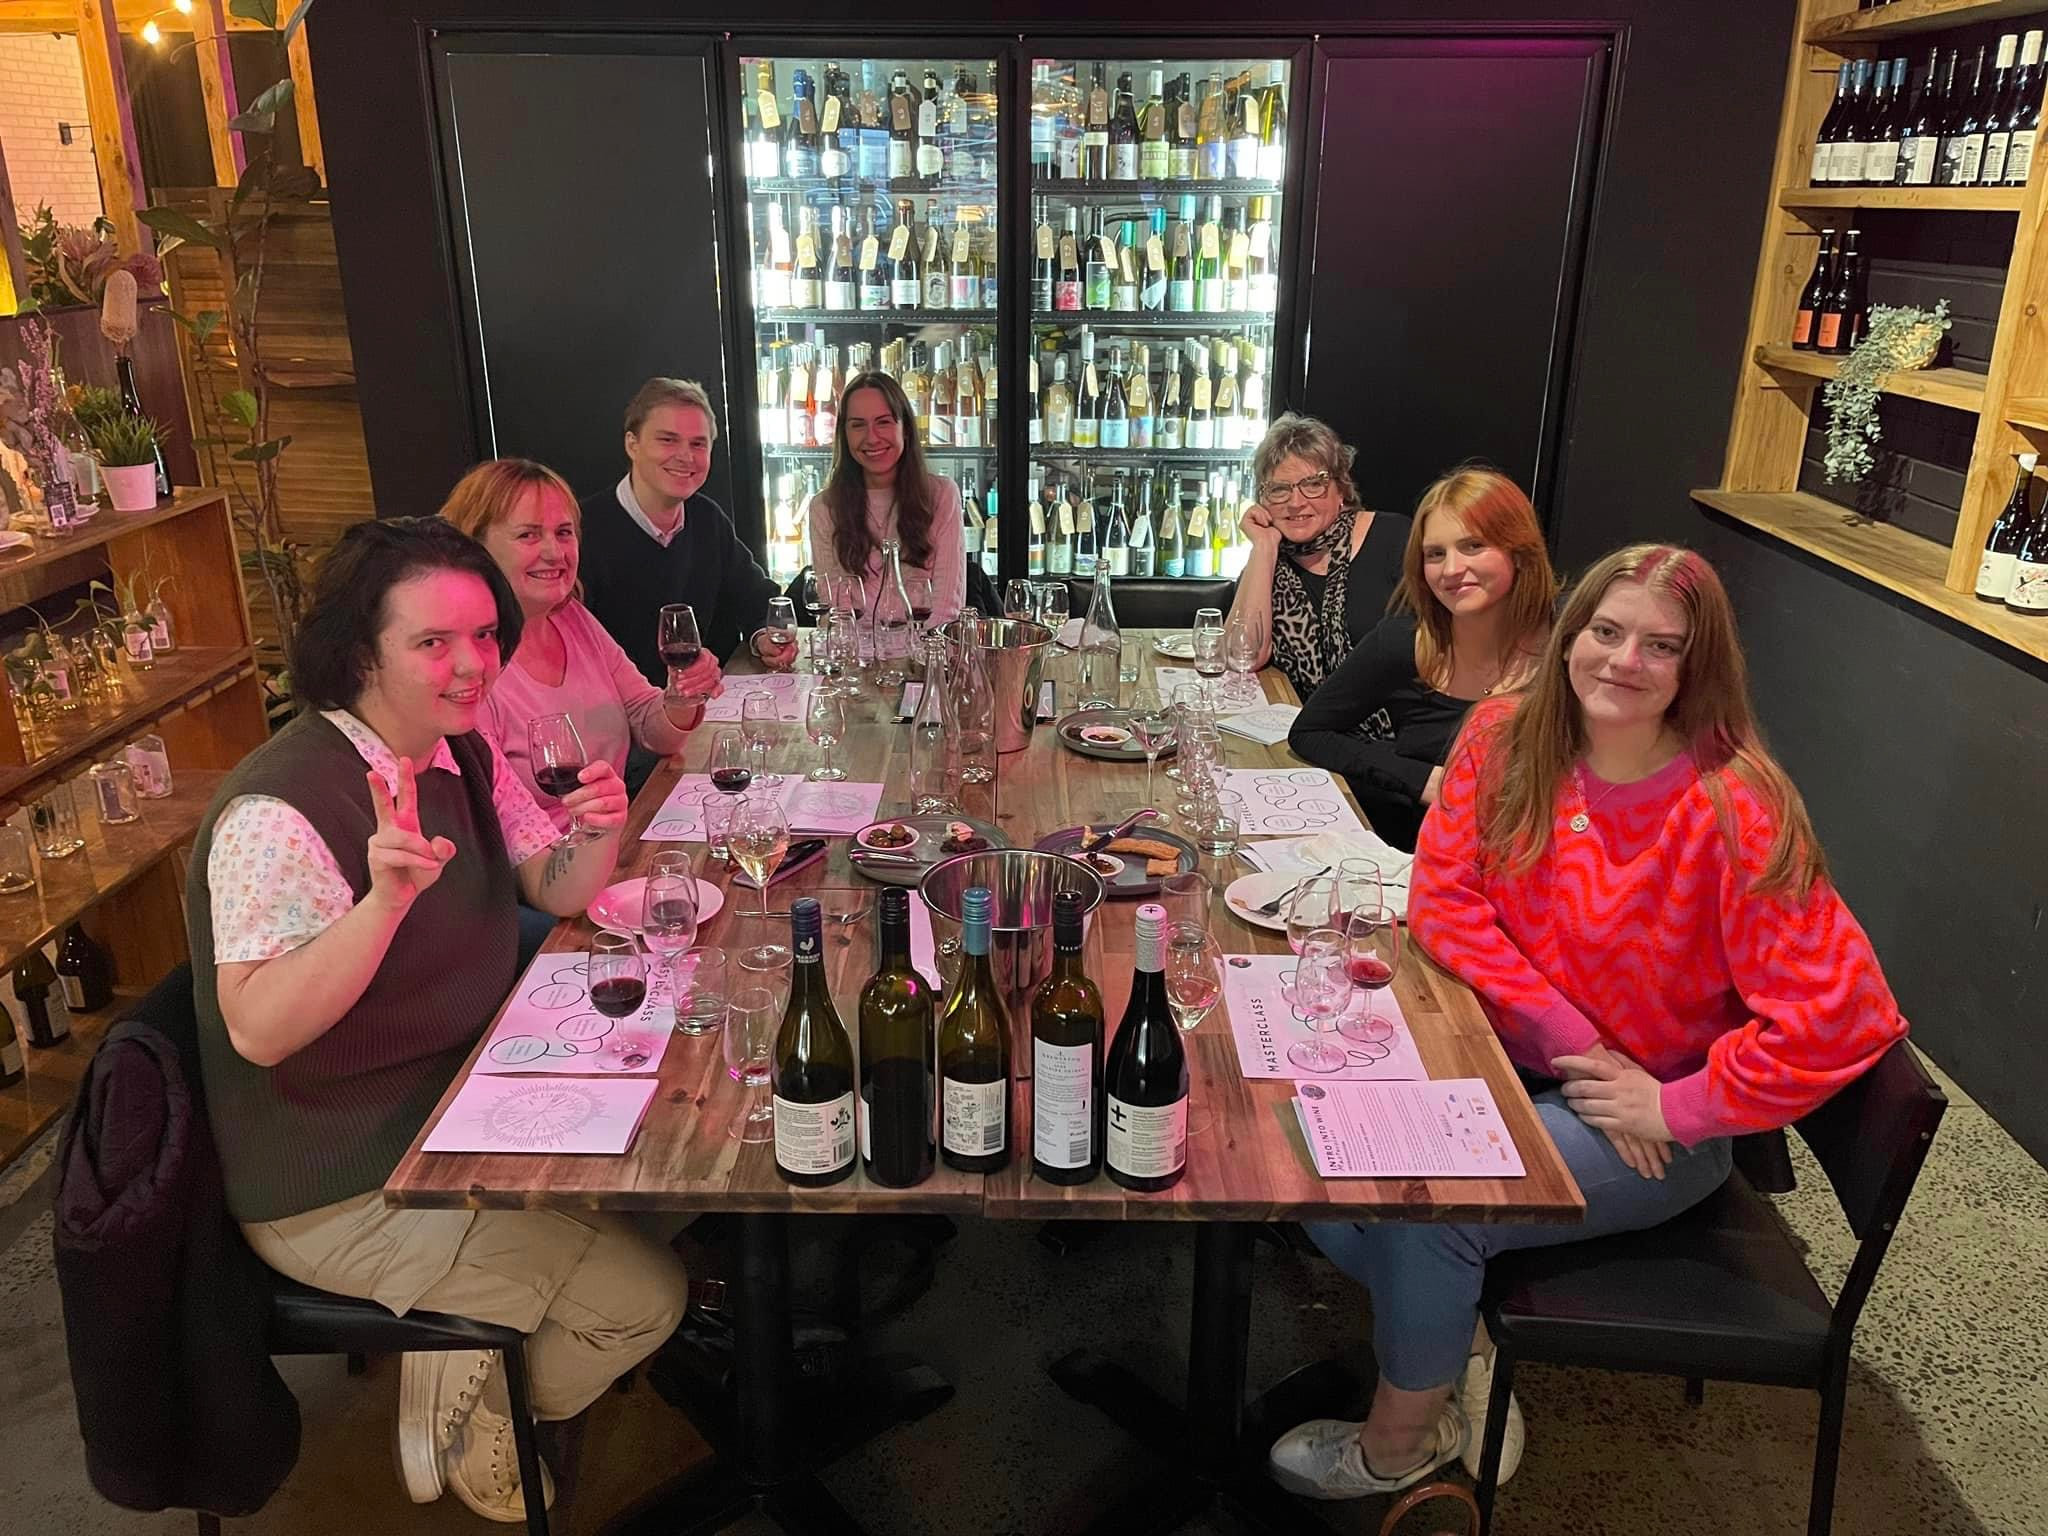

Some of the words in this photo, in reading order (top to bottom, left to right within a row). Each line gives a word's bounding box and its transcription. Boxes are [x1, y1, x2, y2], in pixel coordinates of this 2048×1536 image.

[1250, 997, 1280, 1073] MASTERCLASS
[1311, 1105, 1324, 1124] WINE
[1318, 1124, 1330, 1144] INTO
[1324, 1144, 1338, 1172] INTRO
